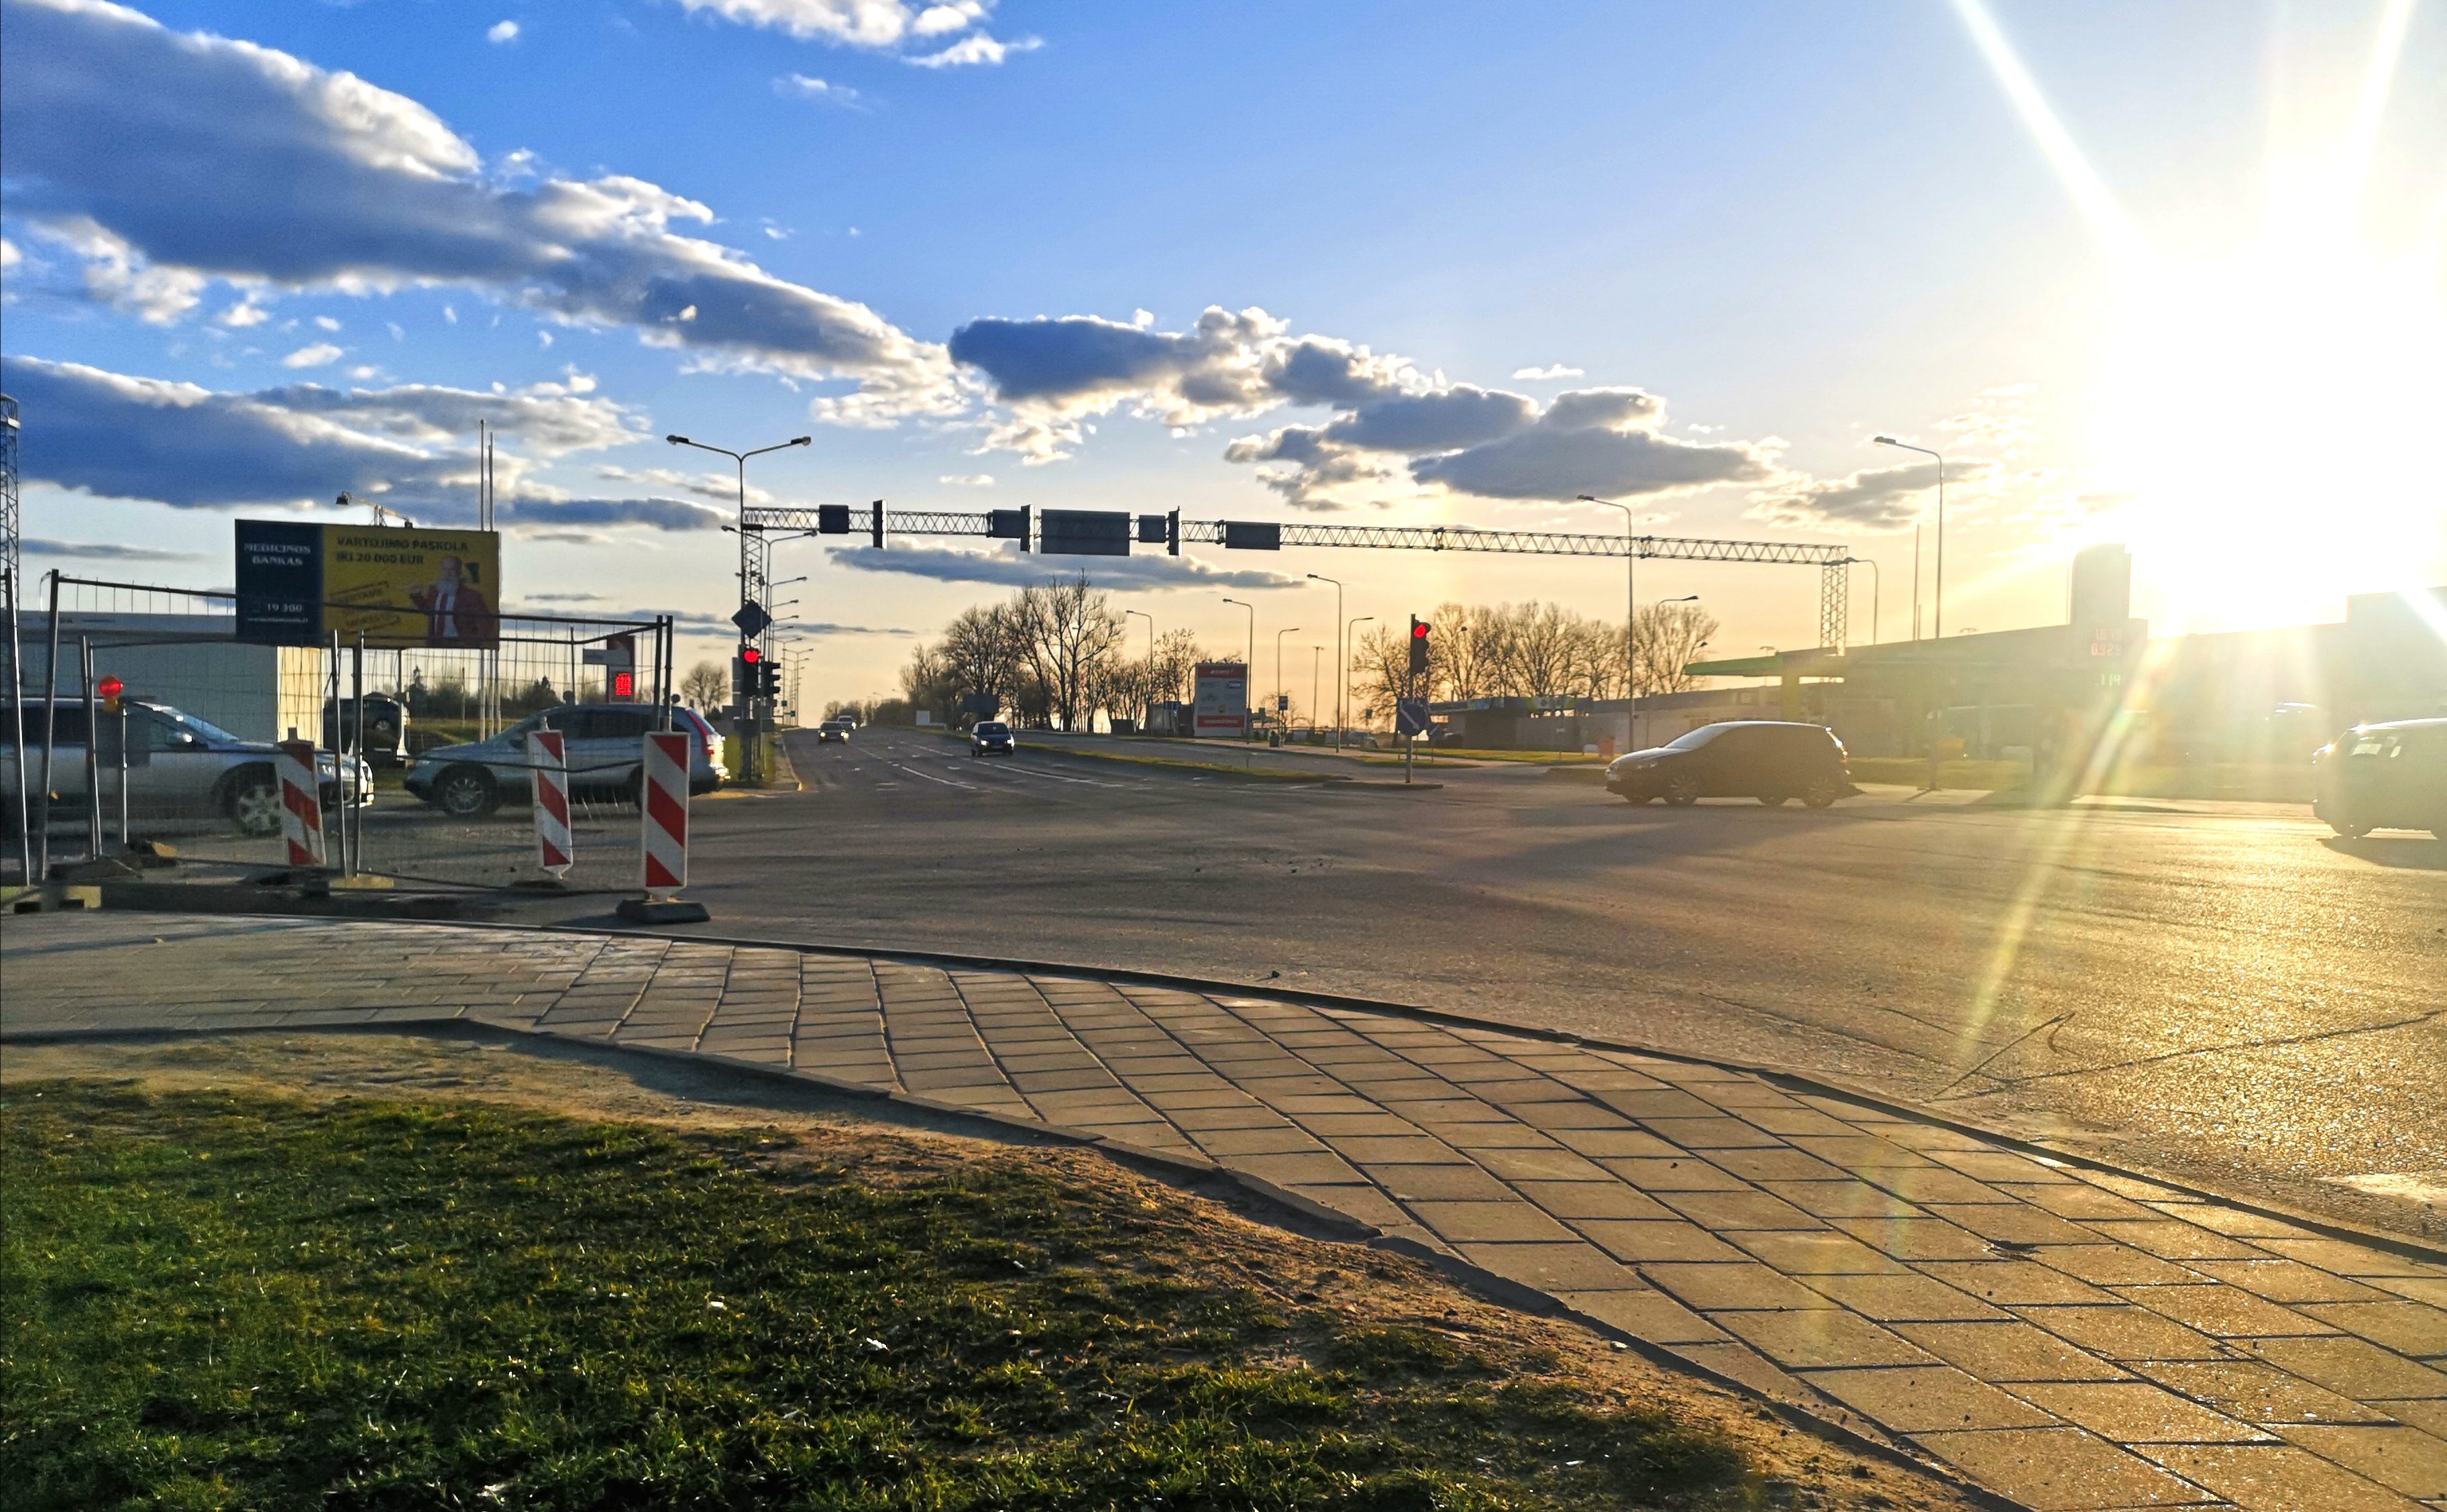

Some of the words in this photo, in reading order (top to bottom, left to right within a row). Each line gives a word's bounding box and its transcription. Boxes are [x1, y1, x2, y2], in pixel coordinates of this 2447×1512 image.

[337, 537, 409, 549] VARTOJIMO
[412, 539, 468, 551] PASKOLA
[252, 555, 303, 565] BANKAS
[356, 552, 371, 562] 20
[400, 553, 424, 564] EUR
[268, 602, 280, 612] 19
[282, 603, 303, 612] 300
